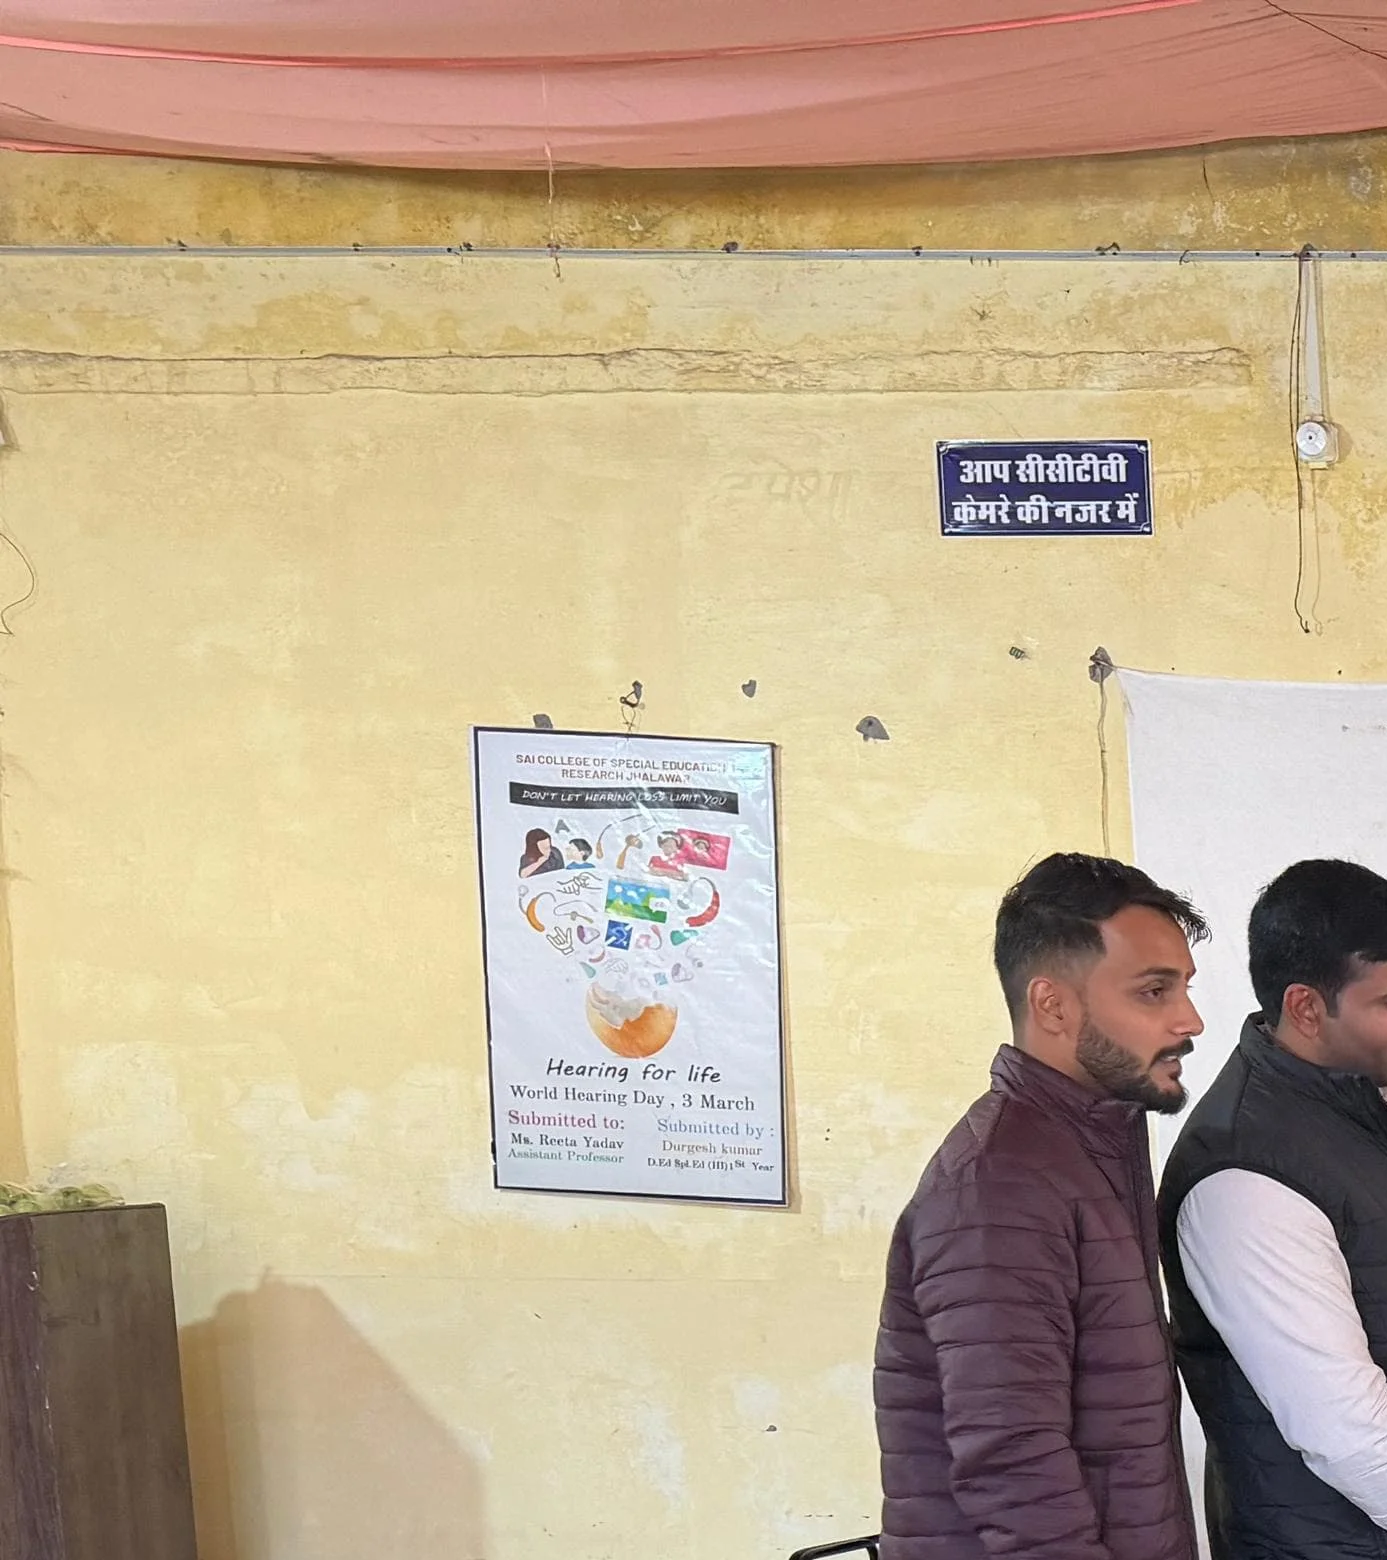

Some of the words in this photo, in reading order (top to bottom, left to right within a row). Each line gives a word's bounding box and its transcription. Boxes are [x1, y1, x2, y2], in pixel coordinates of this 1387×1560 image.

[959, 460, 1011, 483] आप
[1015, 453, 1128, 483] सीसीटीवी
[1015, 494, 1053, 524] की
[1054, 500, 1112, 524] नजर
[1116, 492, 1139, 524] में
[516, 754, 535, 764] SAI
[538, 755, 590, 767] COLLEGE
[593, 758, 607, 767] OF
[610, 759, 659, 770] SPECIAL
[561, 769, 623, 780] RESEARCH
[522, 790, 558, 800] DON'T
[561, 793, 582, 801] LET
[585, 792, 634, 802] HEARING
[670, 794, 701, 802] LIMIT
[704, 795, 727, 805] YOU
[546, 1058, 628, 1082] Hearing
[642, 1063, 676, 1080] for
[688, 1065, 721, 1082] life
[510, 1085, 557, 1100] World
[565, 1087, 627, 1106] Hearing
[634, 1091, 664, 1108] Day
[682, 1093, 692, 1108] 3
[701, 1094, 754, 1111] March
[508, 1110, 597, 1128] Submitted
[603, 1116, 625, 1130] to:
[657, 1119, 739, 1136] Submitted
[746, 1123, 764, 1140] by
[511, 1132, 533, 1145] Ms.
[539, 1134, 577, 1147] Reeta
[583, 1136, 624, 1149] Yadav
[662, 1140, 716, 1154] Durgesh
[721, 1143, 763, 1155] kumar
[508, 1149, 562, 1160] Assistant
[567, 1151, 624, 1163] Professor
[752, 1162, 774, 1172] Year
